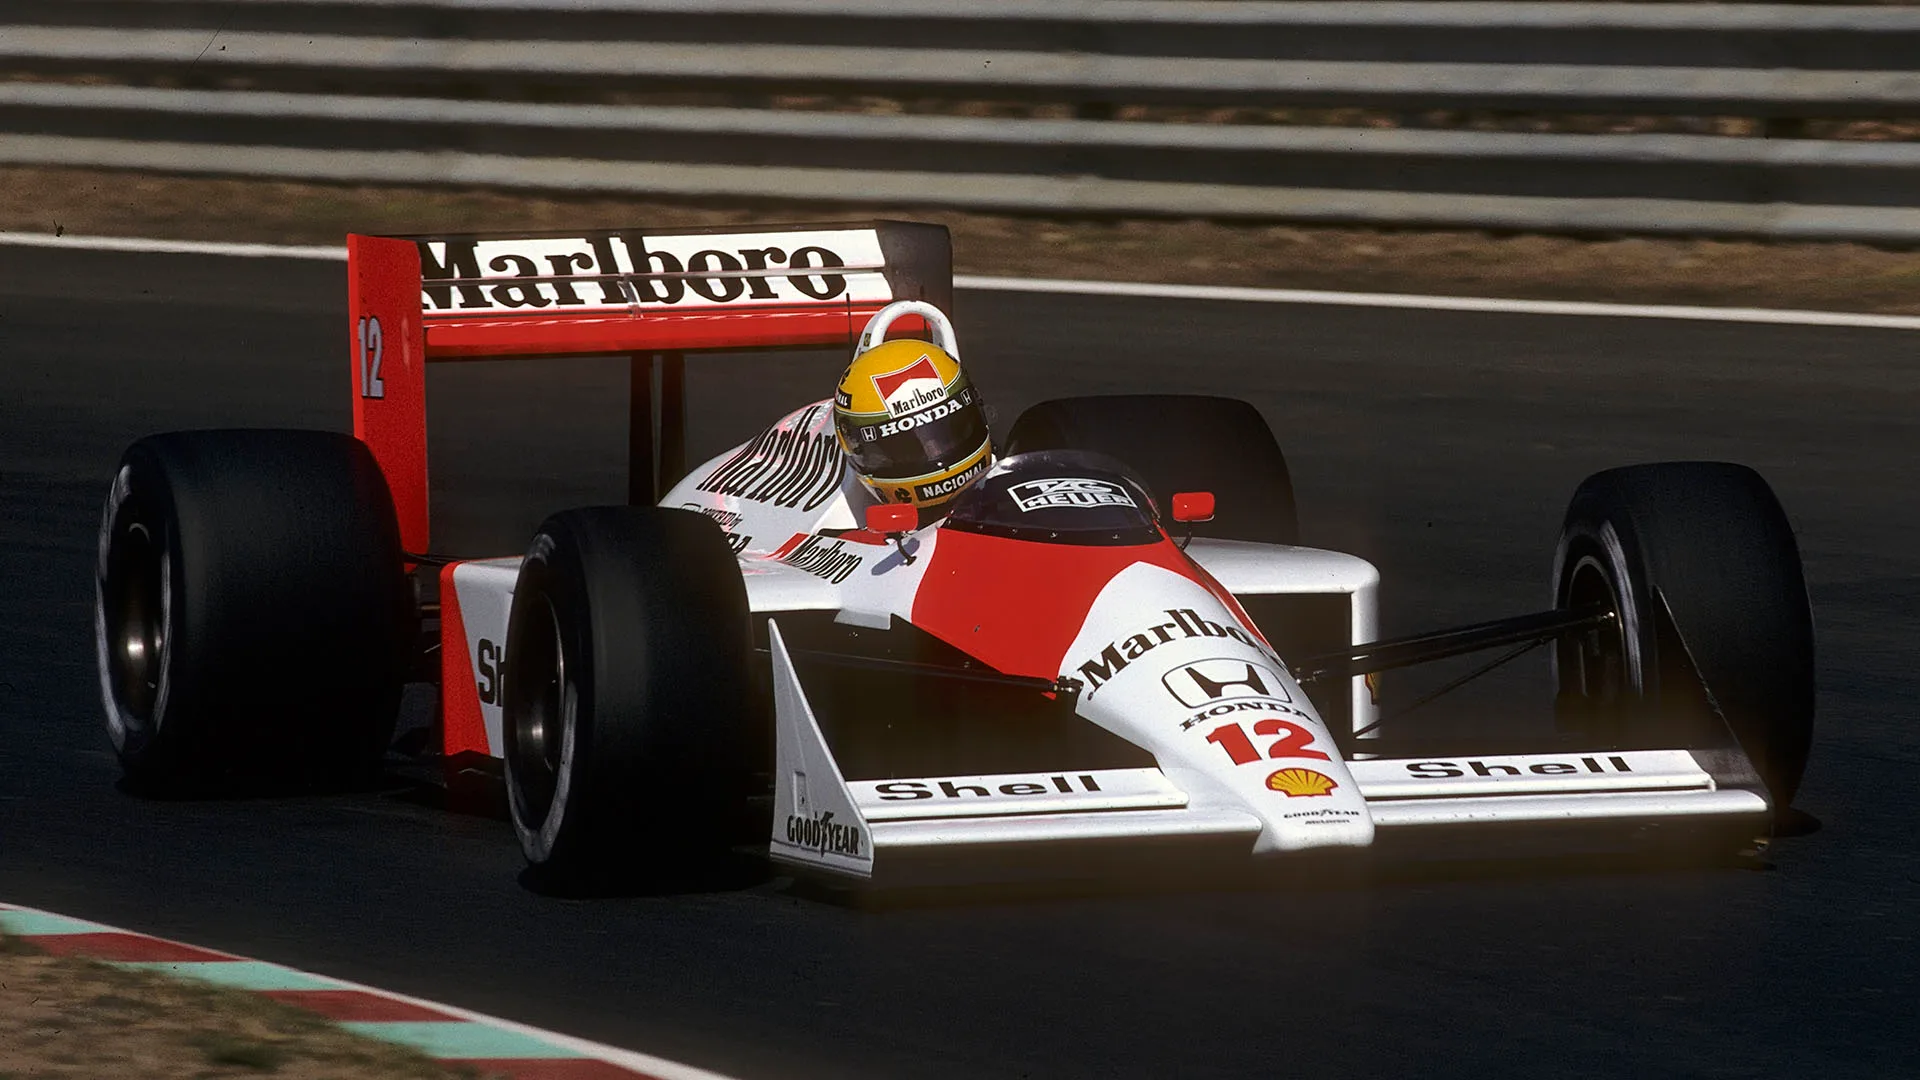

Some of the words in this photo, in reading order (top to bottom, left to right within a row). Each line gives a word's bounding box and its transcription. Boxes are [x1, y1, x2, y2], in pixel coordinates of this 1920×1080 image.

[420, 238, 846, 309] Marlboro
[358, 315, 385, 399] 12
[879, 400, 963, 438] HONDA
[892, 386, 945, 416] Marlboro
[923, 462, 983, 498] NACIONAL
[1077, 608, 1288, 692] Marlbo
[1179, 701, 1318, 733] HONDA
[1205, 718, 1333, 767] 12
[1406, 756, 1633, 779] Shell
[875, 775, 1102, 801] Shell
